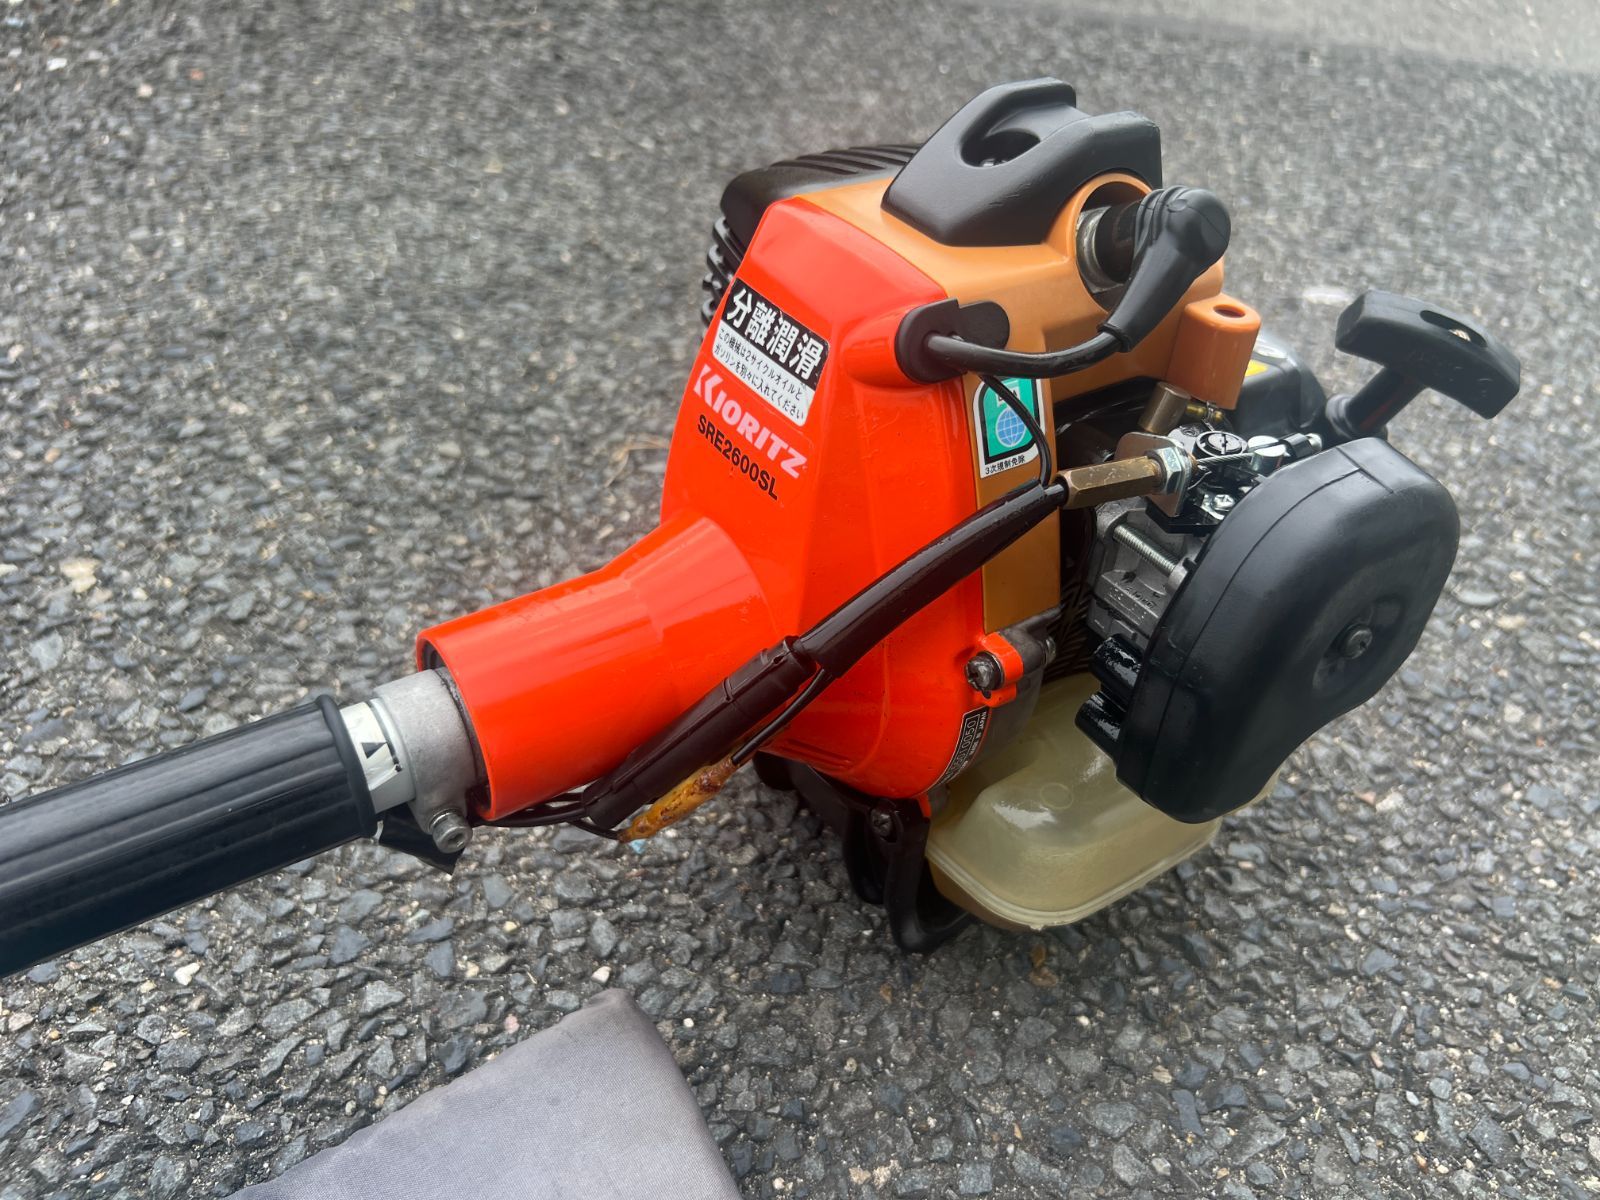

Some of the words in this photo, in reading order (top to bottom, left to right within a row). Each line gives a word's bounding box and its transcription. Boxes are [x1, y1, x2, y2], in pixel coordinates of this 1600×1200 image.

[727, 288, 824, 380] 分離潤滑
[693, 364, 807, 478] KIORITZ
[698, 415, 778, 500] SRE2600SL
